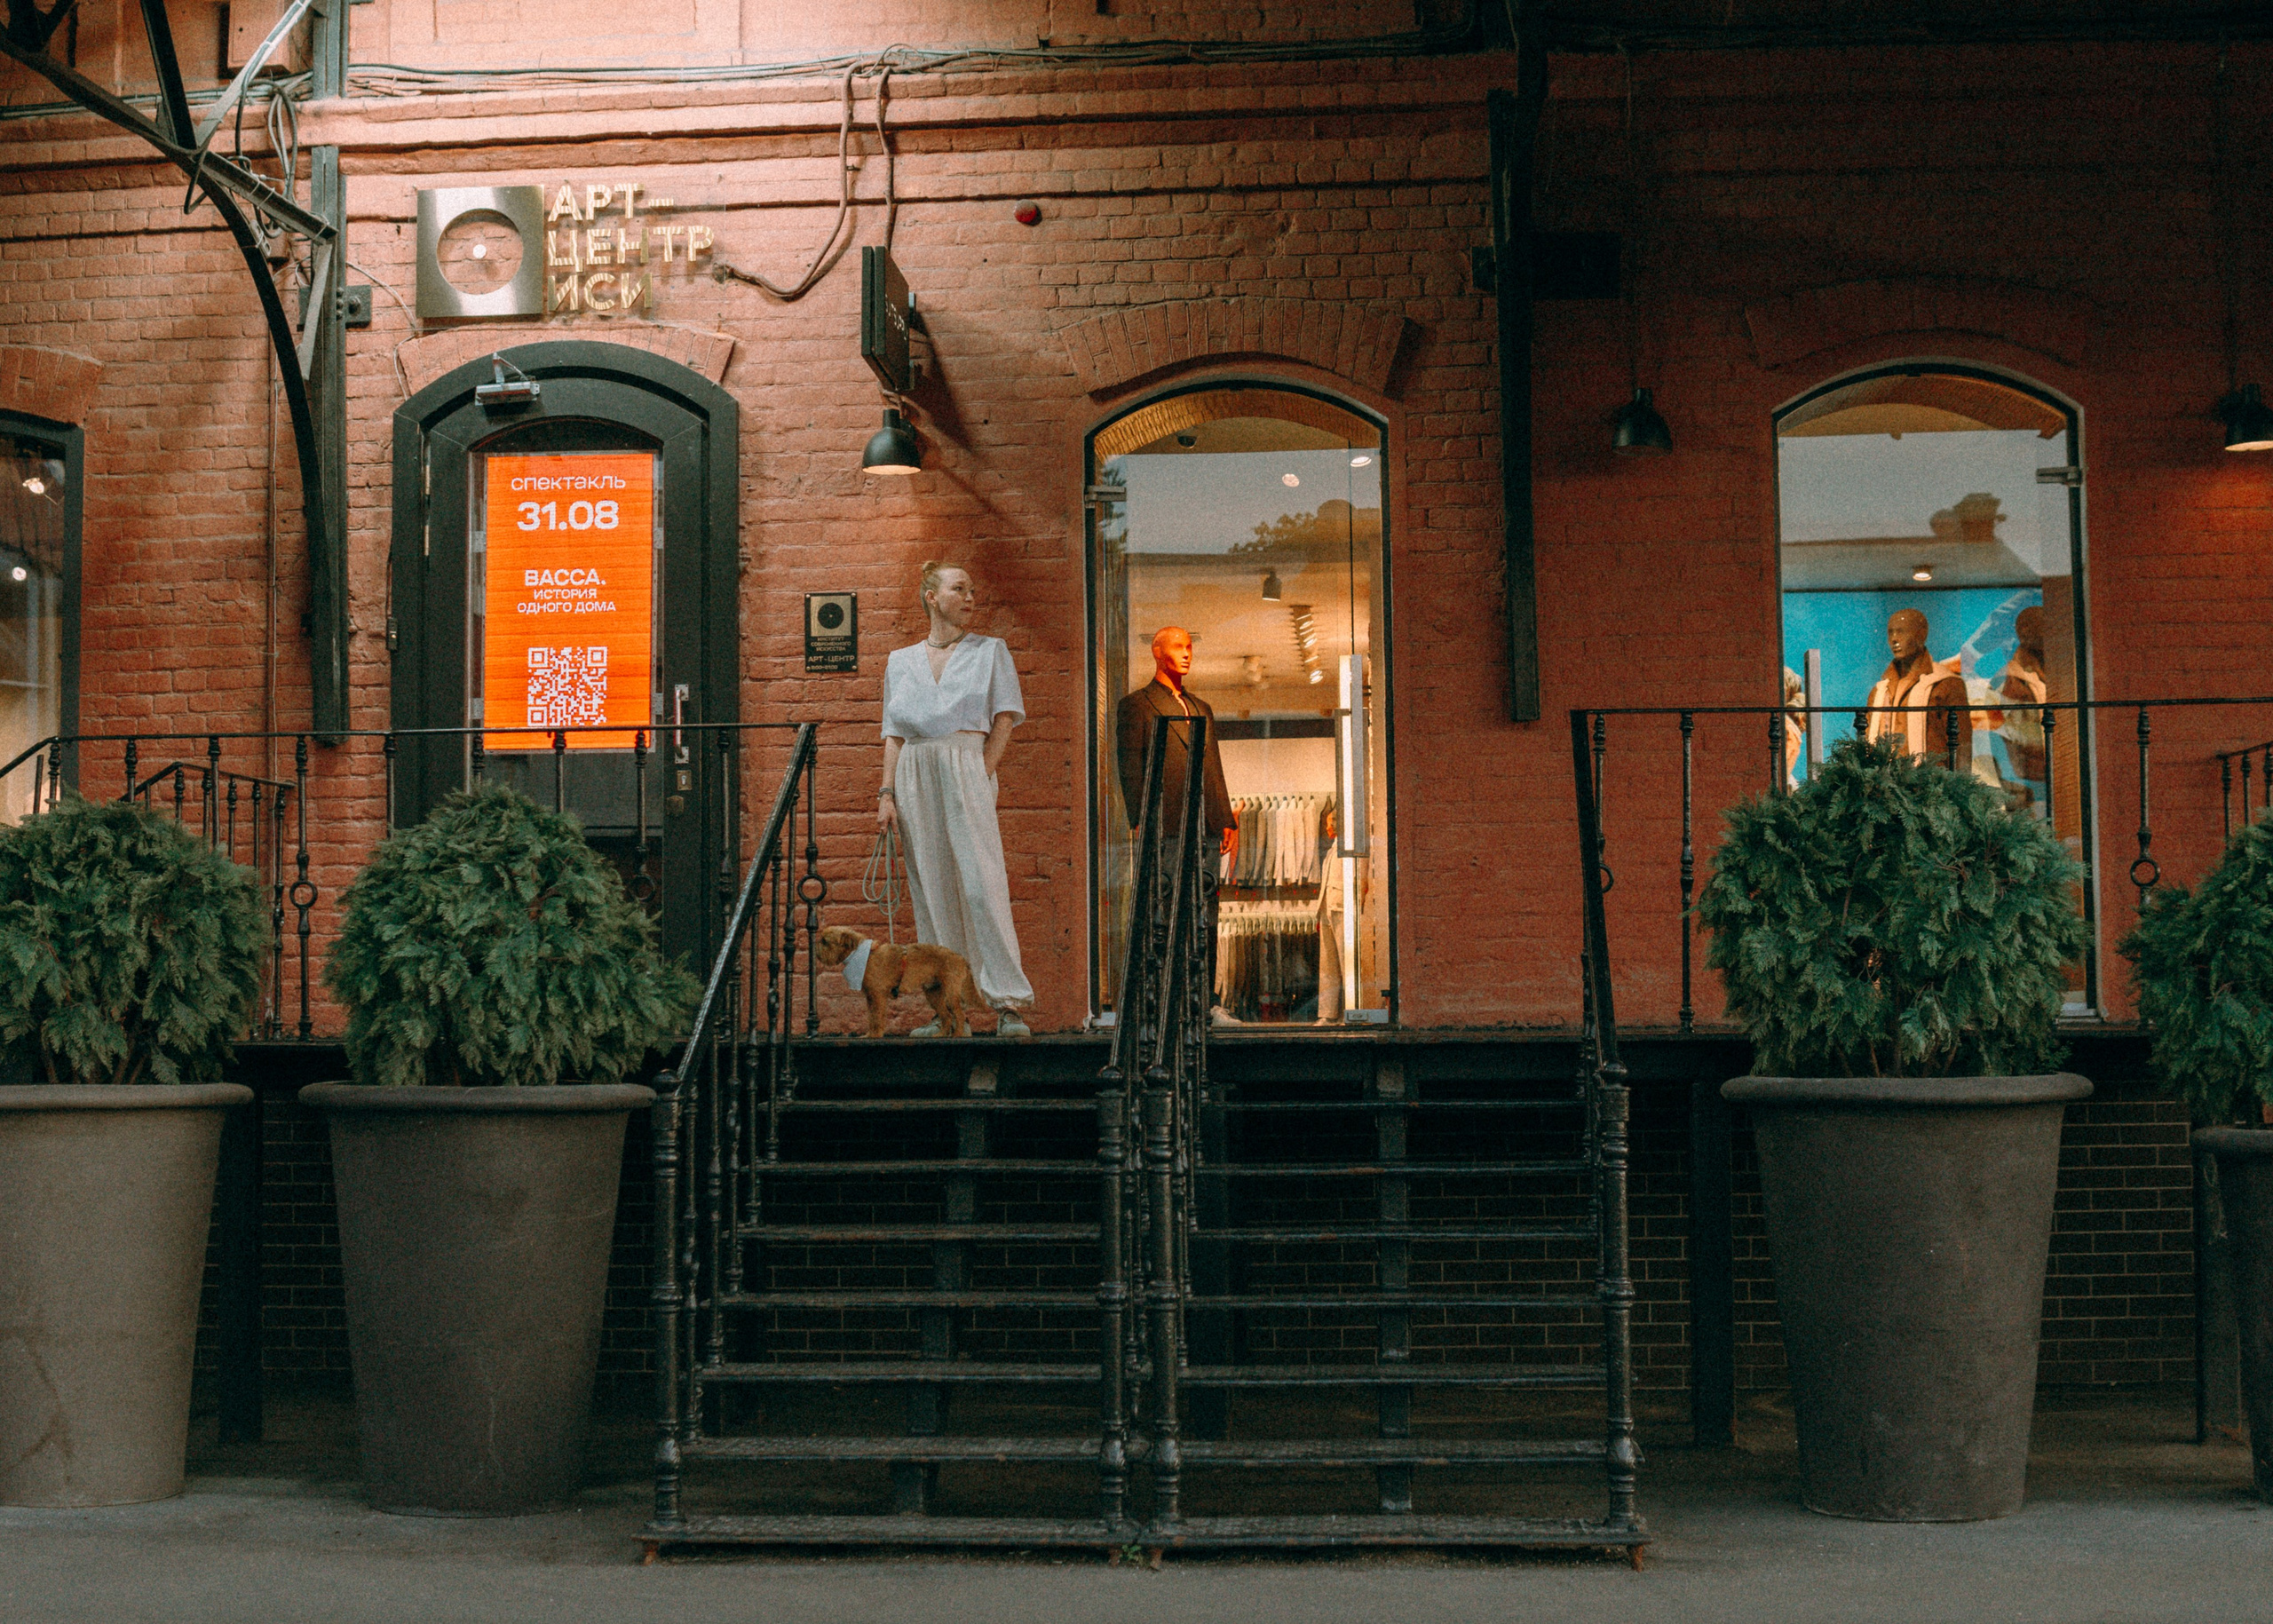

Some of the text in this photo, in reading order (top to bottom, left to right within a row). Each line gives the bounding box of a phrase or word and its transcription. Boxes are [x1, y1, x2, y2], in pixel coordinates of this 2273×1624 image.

[548, 226, 715, 273] ЦЕНТР
[547, 272, 653, 313] ИСИ
[511, 475, 626, 491] спектакль
[517, 500, 620, 531] 31.08
[524, 568, 606, 586] ВАССА.
[534, 588, 598, 600] ИСТОРИЯ
[517, 601, 617, 614] ОДНОГО ДОМА
